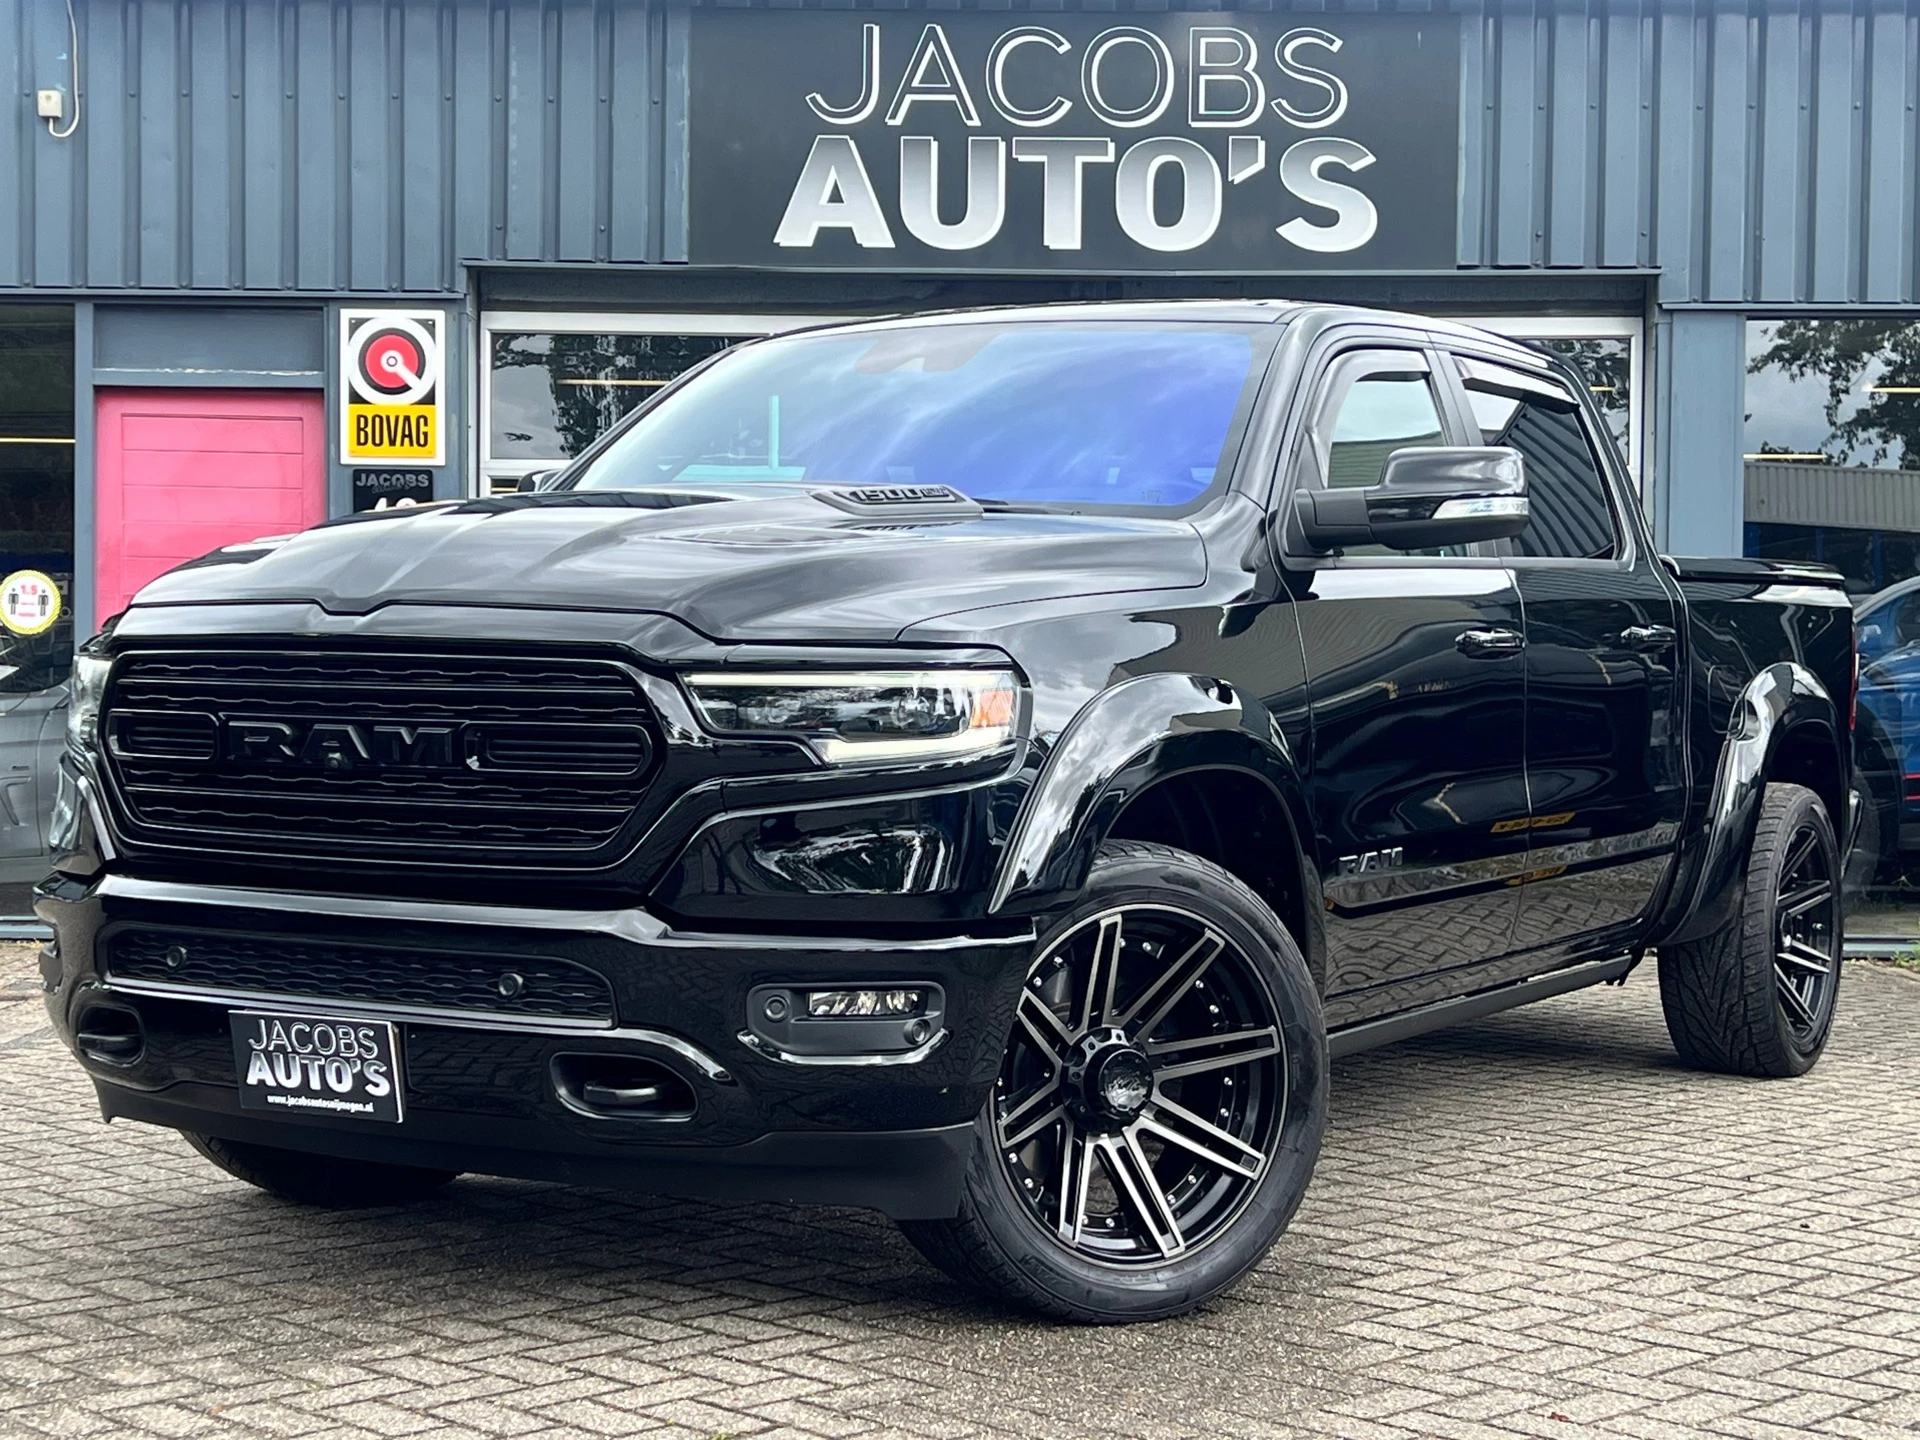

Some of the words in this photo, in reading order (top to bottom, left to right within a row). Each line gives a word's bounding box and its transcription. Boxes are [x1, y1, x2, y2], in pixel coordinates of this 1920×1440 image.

[805, 24, 1349, 128] JACOBS
[772, 135, 1378, 252] AUTO'S
[355, 414, 429, 447] BOVAG
[355, 473, 429, 487] JACOBS
[226, 721, 454, 764] RAM
[248, 1018, 379, 1060] JACOBS
[246, 1050, 391, 1097] AUTO'S
